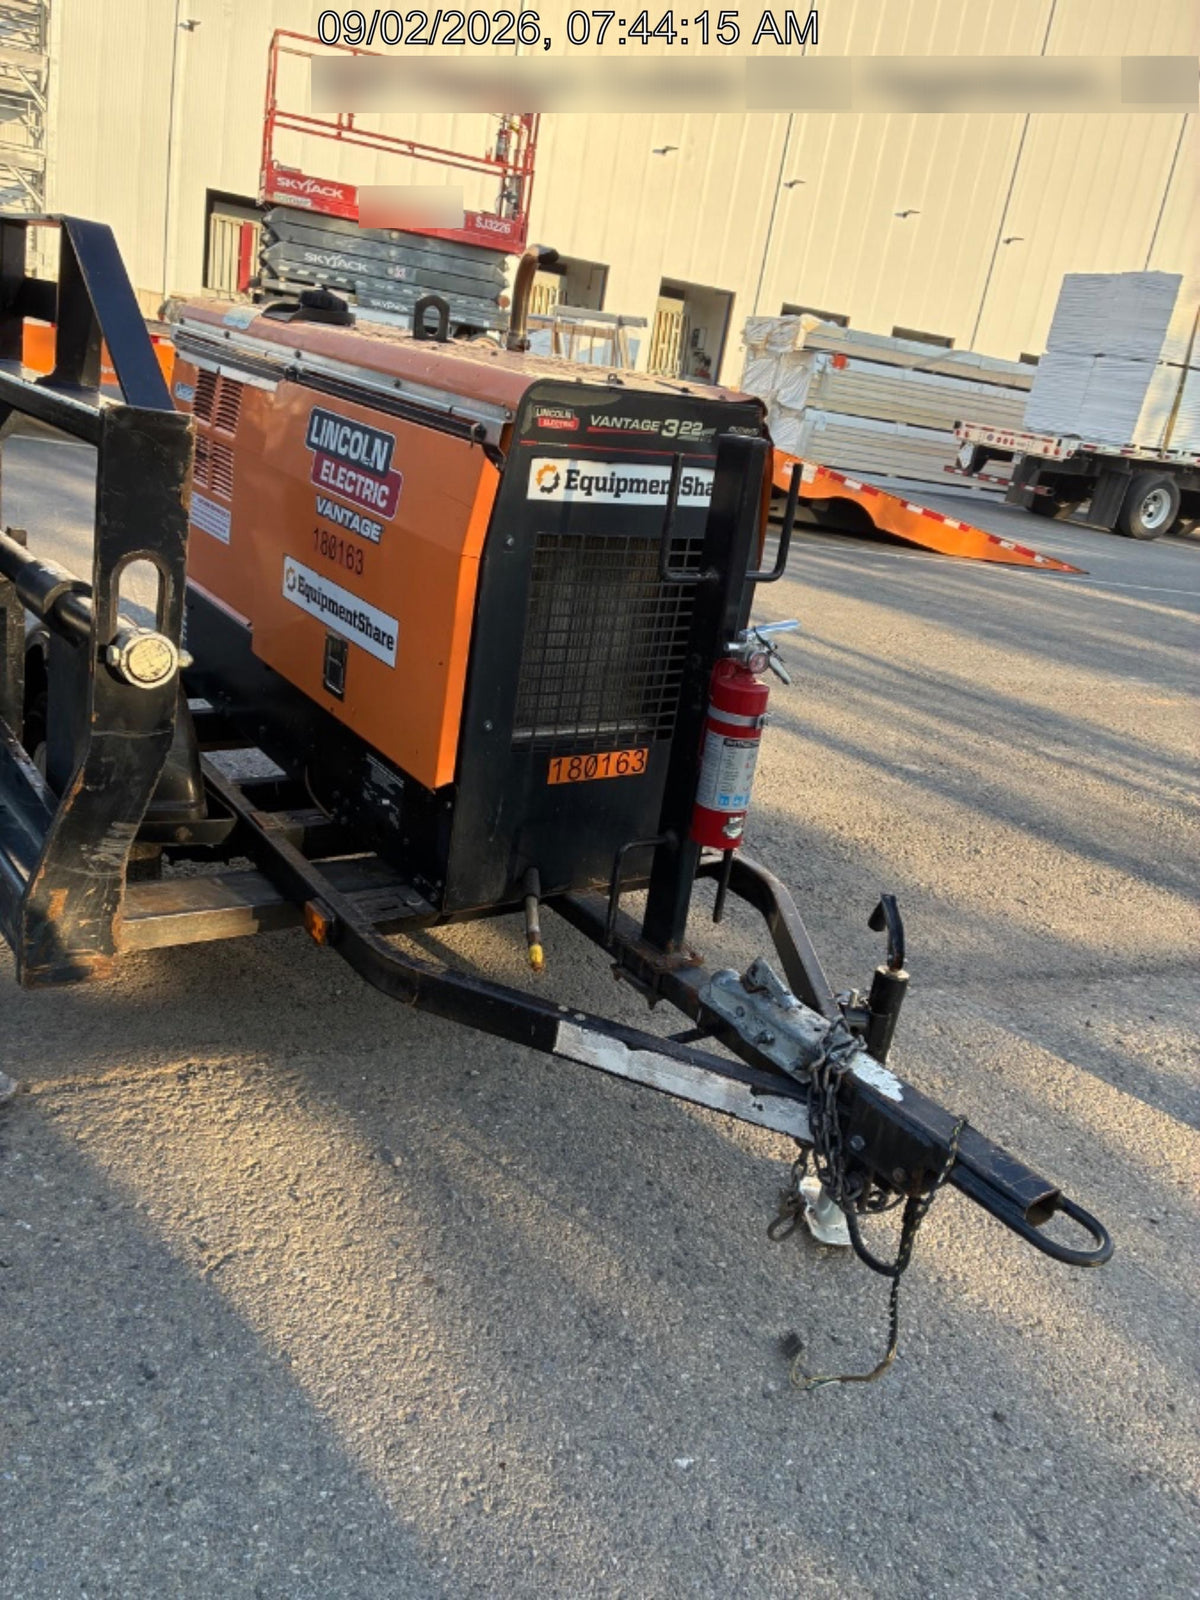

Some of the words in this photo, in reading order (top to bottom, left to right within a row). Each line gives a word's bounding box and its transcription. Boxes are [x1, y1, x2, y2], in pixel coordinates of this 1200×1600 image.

[277, 176, 344, 199] SKYJACK
[304, 252, 368, 273] SKYJACK
[310, 414, 389, 472] LINCOLN
[590, 414, 660, 432] VANTAGE
[661, 418, 704, 437] 322
[320, 458, 391, 509] ELECTRIC
[316, 495, 383, 543] VANTAGE
[313, 528, 364, 575] 180163
[297, 571, 395, 651] EquipmentShare
[553, 749, 645, 782] 180163
